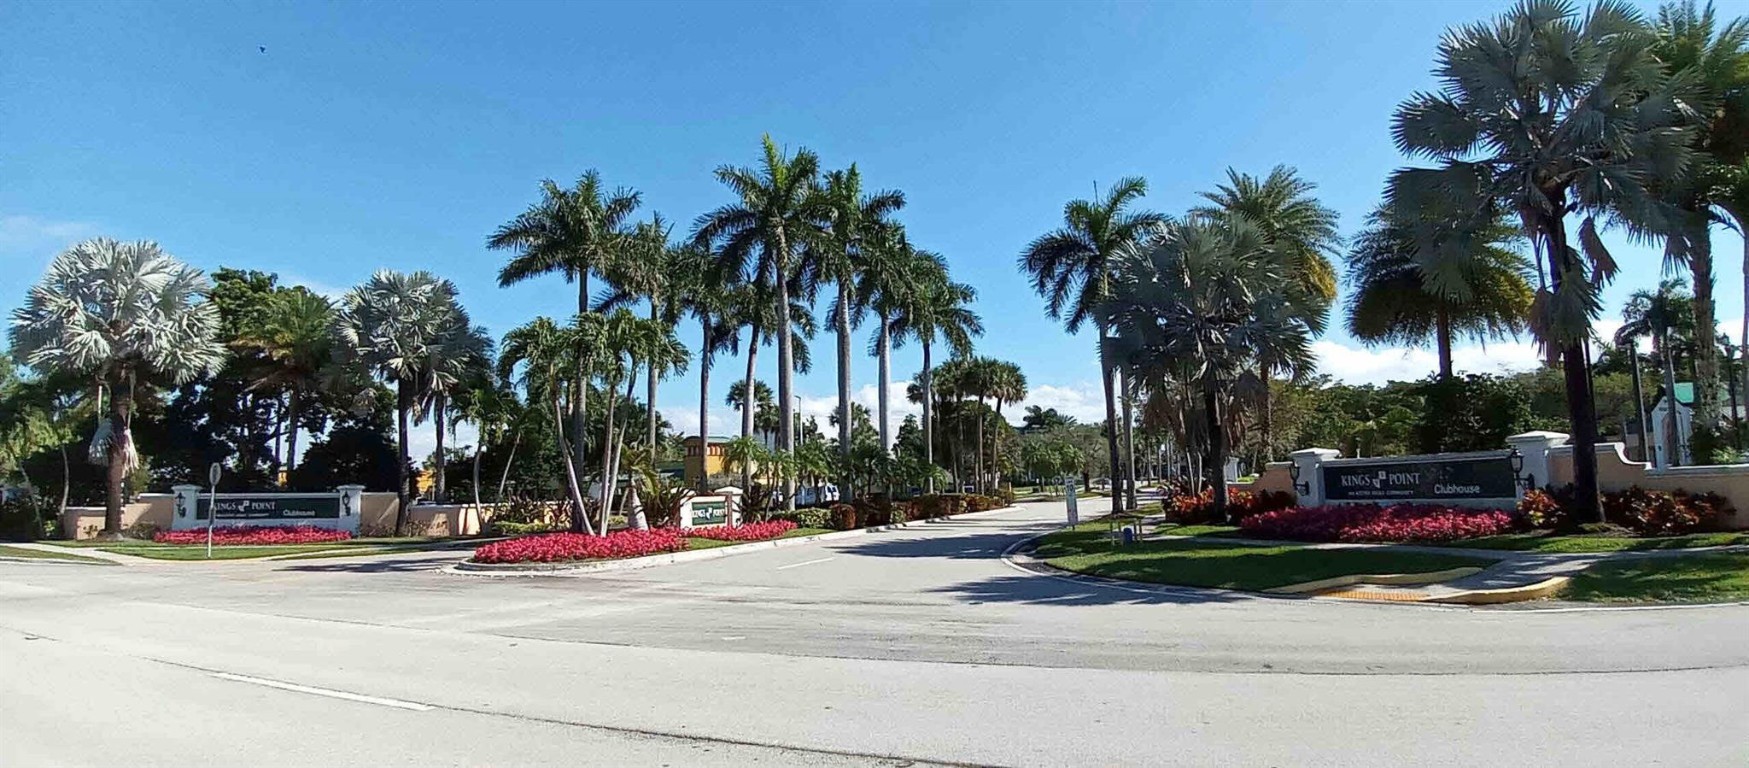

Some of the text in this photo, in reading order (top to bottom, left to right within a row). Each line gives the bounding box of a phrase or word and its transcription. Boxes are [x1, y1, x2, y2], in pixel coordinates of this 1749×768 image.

[1341, 472, 1420, 486] KINGS POINT
[1434, 483, 1480, 494] Clubhouse
[251, 501, 275, 510] POINT
